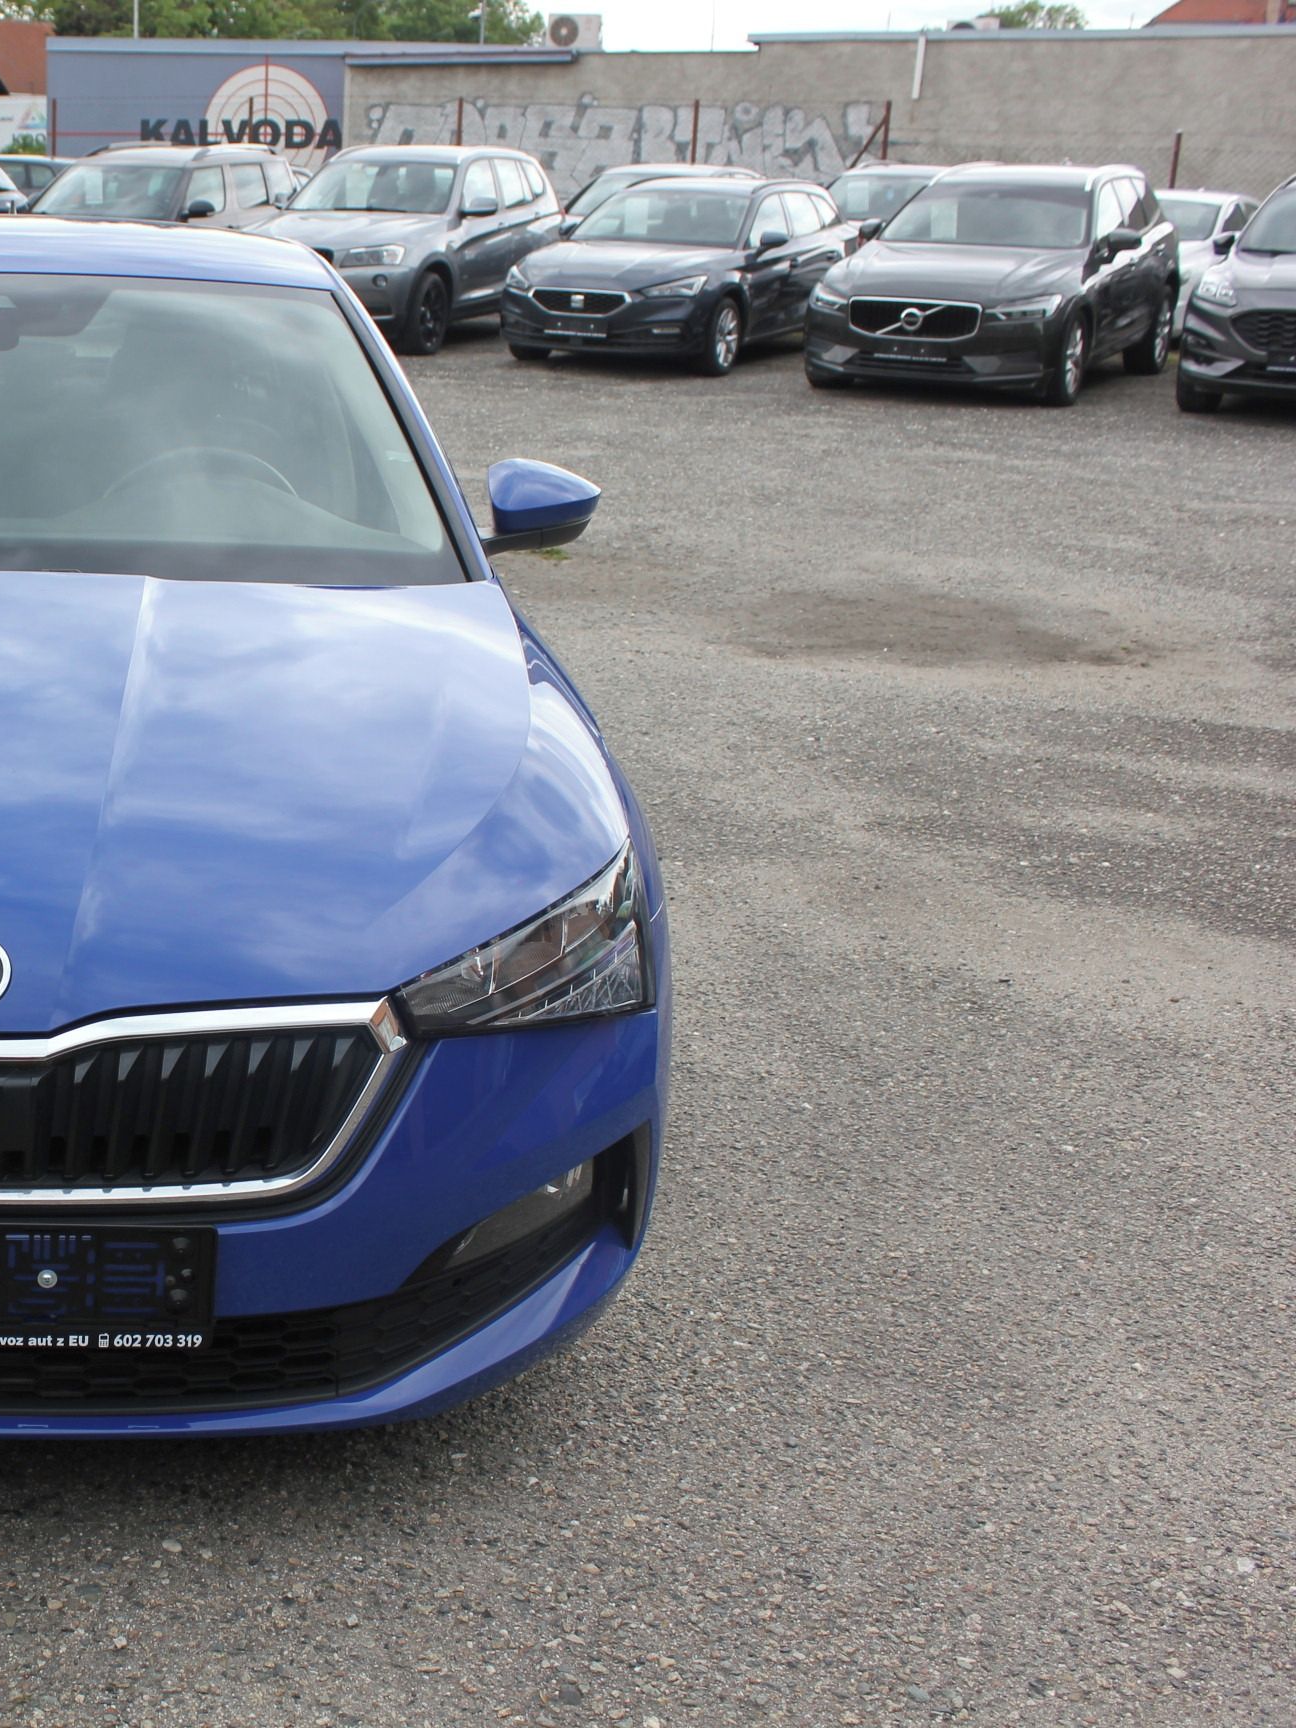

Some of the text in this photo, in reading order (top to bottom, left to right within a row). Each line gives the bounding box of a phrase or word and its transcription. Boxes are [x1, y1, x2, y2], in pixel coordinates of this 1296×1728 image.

[140, 118, 343, 149] KALVODA
[28, 1335, 53, 1347] aut
[56, 1338, 64, 1347] z
[68, 1335, 89, 1347] EU
[113, 1334, 142, 1348] 602
[145, 1334, 173, 1348] 703
[176, 1334, 203, 1348] 319
